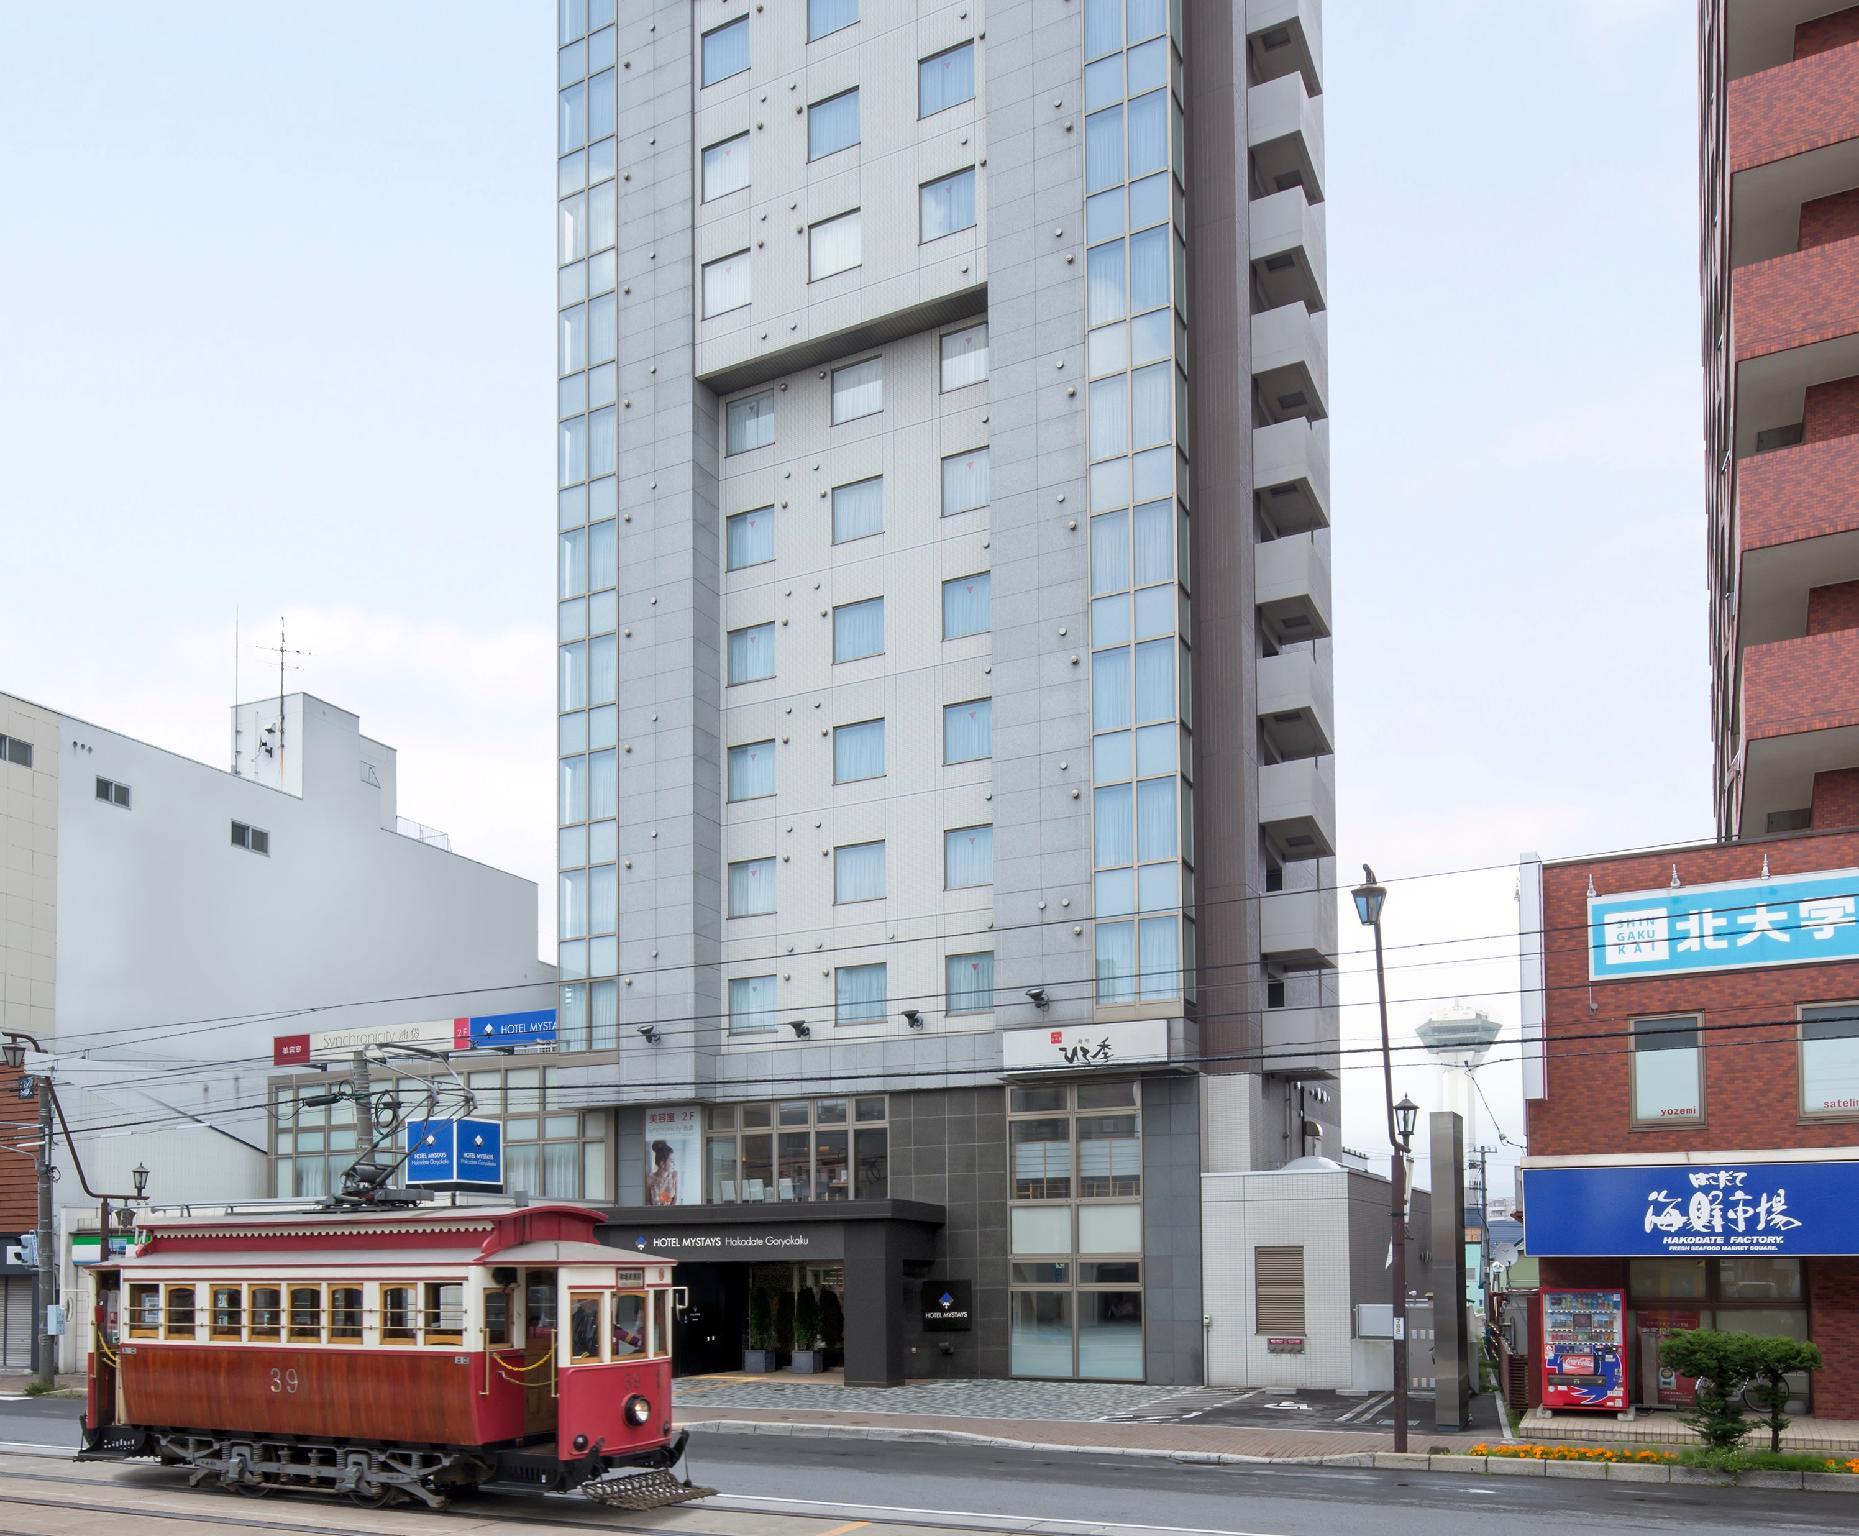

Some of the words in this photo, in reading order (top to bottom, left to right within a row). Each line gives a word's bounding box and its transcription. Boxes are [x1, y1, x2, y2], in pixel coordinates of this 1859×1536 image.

[1617, 917, 1655, 928] SHIN
[1675, 897, 1857, 953] 北大学
[1616, 930, 1656, 942] GAKU
[1618, 942, 1656, 955] KAI
[500, 1023, 527, 1034] HOTEL
[1660, 1105, 1697, 1117] yozemi
[1689, 1170, 1748, 1189] はこだて
[1645, 1188, 1802, 1233] 海鮮市場
[653, 1237, 681, 1248] HOTEL
[682, 1236, 721, 1247] MYSTAYS
[725, 1236, 763, 1247] Hakodate
[764, 1234, 809, 1248] Goryokaku
[1663, 1236, 1725, 1244] HAKODATE
[925, 1311, 942, 1319] HOTEL
[943, 1311, 968, 1319] MYSTAYS
[270, 1367, 298, 1393] 39
